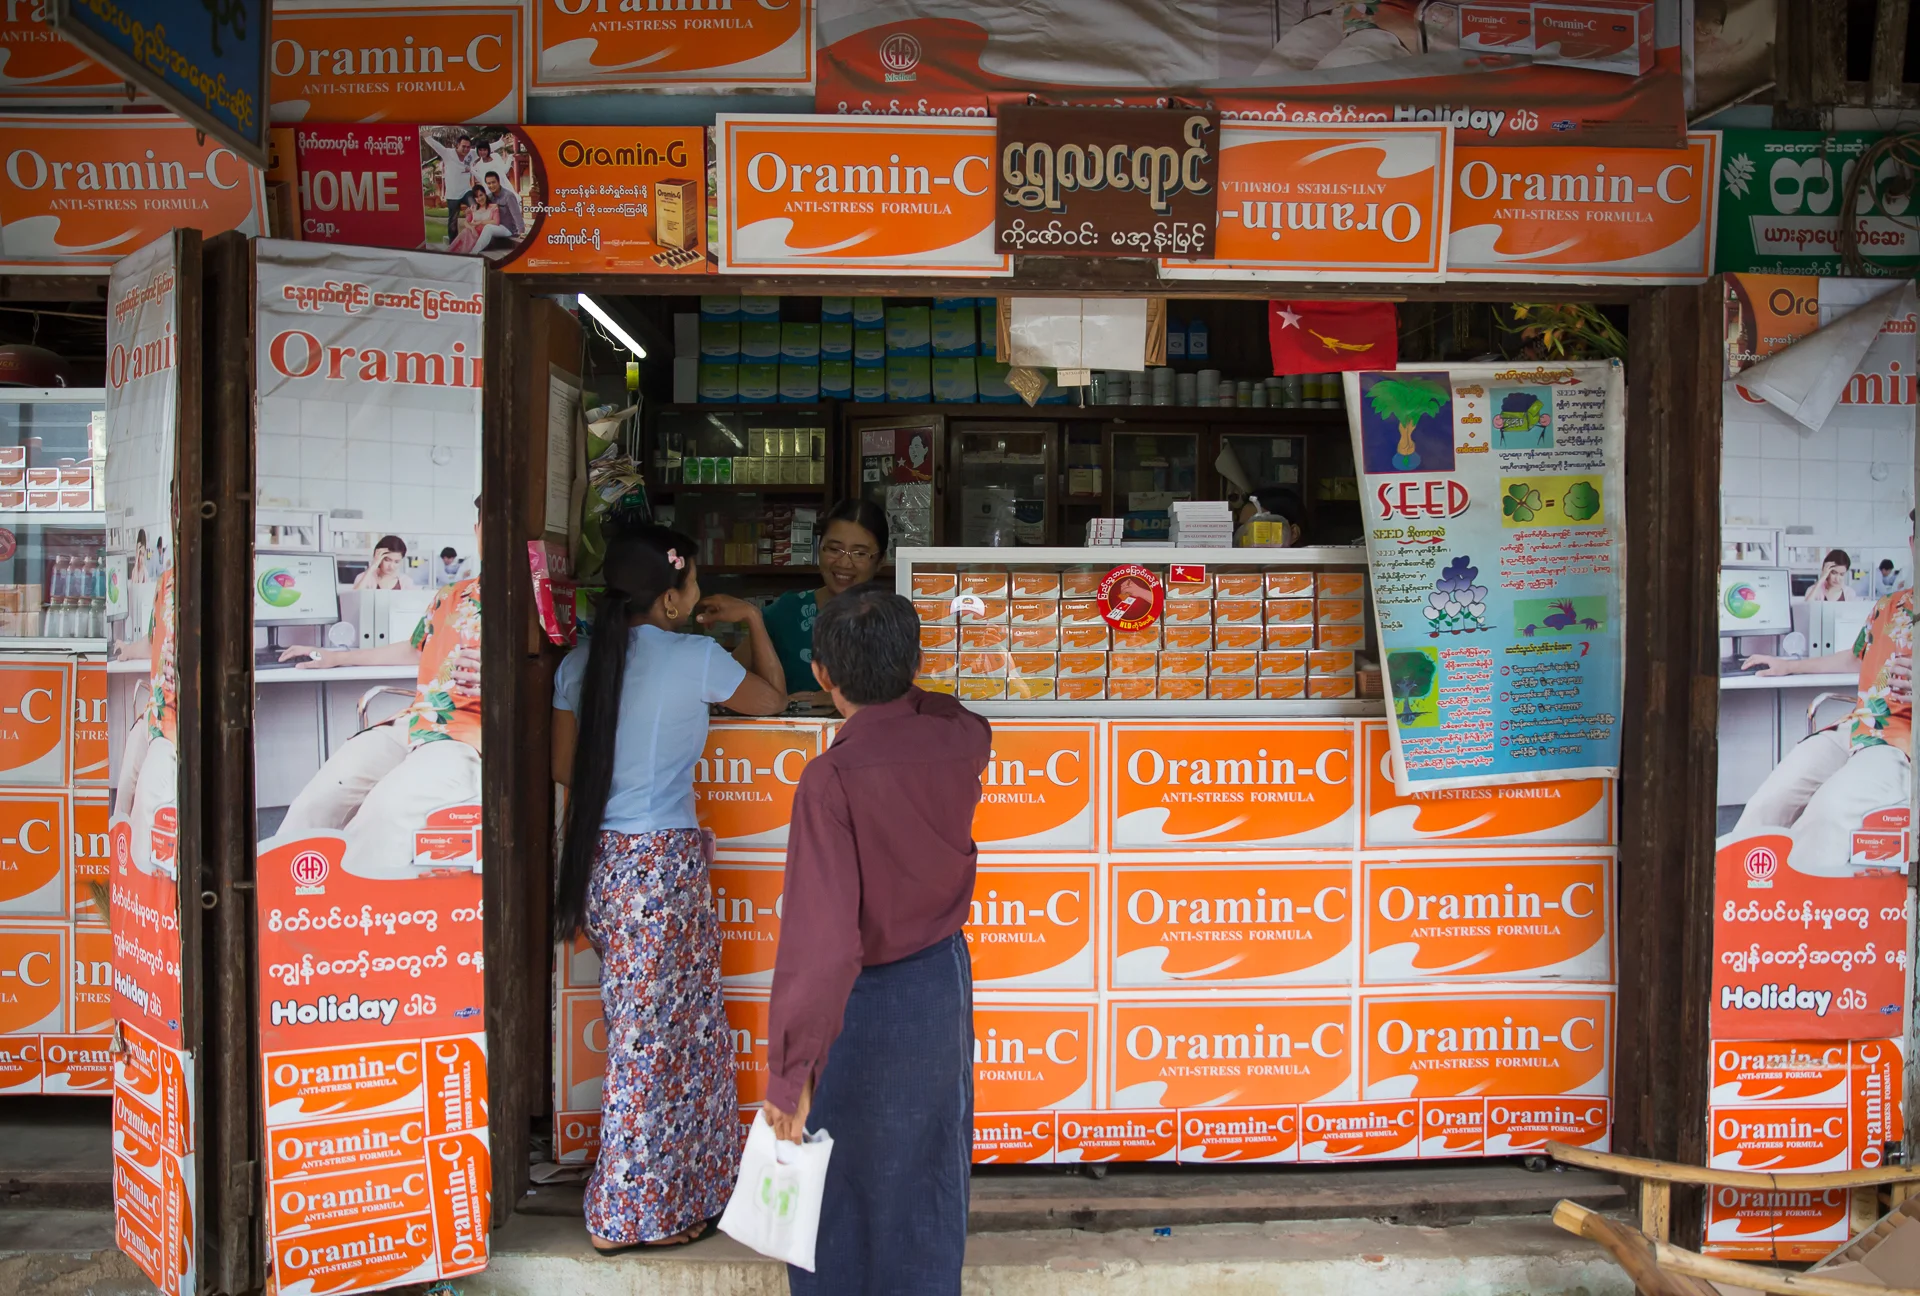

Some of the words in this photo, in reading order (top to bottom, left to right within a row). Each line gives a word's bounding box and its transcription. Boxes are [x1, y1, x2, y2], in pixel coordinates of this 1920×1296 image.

[590, 20, 677, 32] ANTI-STRESS
[684, 18, 753, 30] FORMULA
[1467, 15, 1507, 25] Oramin-C
[1542, 16, 1597, 31] Oramin-C
[271, 34, 501, 76] Oramin-C
[302, 82, 389, 94] ANTI-STRESS
[397, 81, 465, 92] FORMULA
[885, 74, 917, 82] Medical
[557, 139, 688, 168] Oramin-G
[7, 147, 238, 190] Oramin-C
[748, 153, 988, 196] Oramin-C
[1221, 182, 1289, 193] FORMULA
[1297, 184, 1386, 194] ANTI-STRESS
[1460, 161, 1692, 203] Oramin-C
[49, 199, 139, 211] ANTI-STRESS
[143, 199, 210, 210] FORMULA
[784, 202, 873, 214] ANTI-STRESS
[881, 203, 951, 214] FORMULA
[1494, 209, 1579, 221] ANTI-STRESS
[1587, 211, 1653, 222] FORMULA
[303, 219, 340, 237] Cap.
[1377, 480, 1470, 520] SEED
[1373, 530, 1404, 539] SEED
[1128, 749, 1348, 785] Oramin-C
[709, 791, 773, 801] FORMULA
[980, 793, 1045, 803] FORMULA
[1161, 792, 1244, 802] ANTI-STRESS
[1251, 792, 1314, 802] FORMULA
[1499, 788, 1561, 798] FORMULA
[1128, 887, 1346, 925] Oramin-C
[1379, 883, 1593, 922] Oramin-C
[981, 933, 1045, 943] FORMULA
[1161, 931, 1243, 941] ANTI-STRESS
[1249, 930, 1312, 940] FORMULA
[1411, 926, 1491, 937] ANTI-STRESS
[1497, 925, 1560, 935] FORMULA
[114, 969, 149, 1016] Holiday
[1721, 983, 1832, 1017] Holiday
[1836, 987, 1868, 1010] ပါပဲ
[271, 994, 399, 1026] Holiday
[403, 994, 437, 1016] ပါပဲ
[1126, 1023, 1344, 1060] Oramin-C
[1378, 1017, 1594, 1054] Oramin-C
[274, 1052, 417, 1087] Oramin-C
[1159, 1066, 1240, 1077] ANTI-STRESS
[1247, 1065, 1310, 1076] FORMULA
[1410, 1058, 1489, 1070] ANTI-STRESS
[1496, 1058, 1559, 1067] FORMULA
[1719, 1048, 1842, 1072] Oramin-C
[980, 1070, 1044, 1080] FORMULA
[1883, 1062, 1891, 1100] FORMULA
[297, 1083, 352, 1095] ANTI-STRESS
[355, 1078, 397, 1089] FORMULA
[436, 1043, 462, 1132] amin-C
[1491, 1107, 1602, 1126] Oramin-C
[1860, 1044, 1882, 1169] Oramin-C
[117, 1097, 160, 1145] Oramin-C
[972, 1121, 1050, 1140] amin-C
[1062, 1119, 1173, 1140] Oramin-C
[1184, 1115, 1294, 1136] Oramin-C
[1305, 1109, 1414, 1132] Oramin-C
[1719, 1117, 1842, 1140] Oramin-C
[278, 1121, 422, 1161] Oramin-C
[301, 1155, 356, 1169] ANTI-STRESS
[360, 1149, 402, 1160] FORMULA
[119, 1165, 161, 1218] Oramin-C
[280, 1172, 424, 1214] Oramin-C
[1717, 1187, 1841, 1208] Oramin-C
[304, 1207, 358, 1223] ANTI-STRESS
[362, 1201, 404, 1213] FORMULA
[439, 1140, 475, 1266] Oramin-C
[120, 1217, 161, 1271] Oramin-C
[284, 1223, 427, 1269] Oramin-C
[308, 1260, 362, 1276] ANTI-STRESS
[365, 1252, 408, 1265] FORMULA
